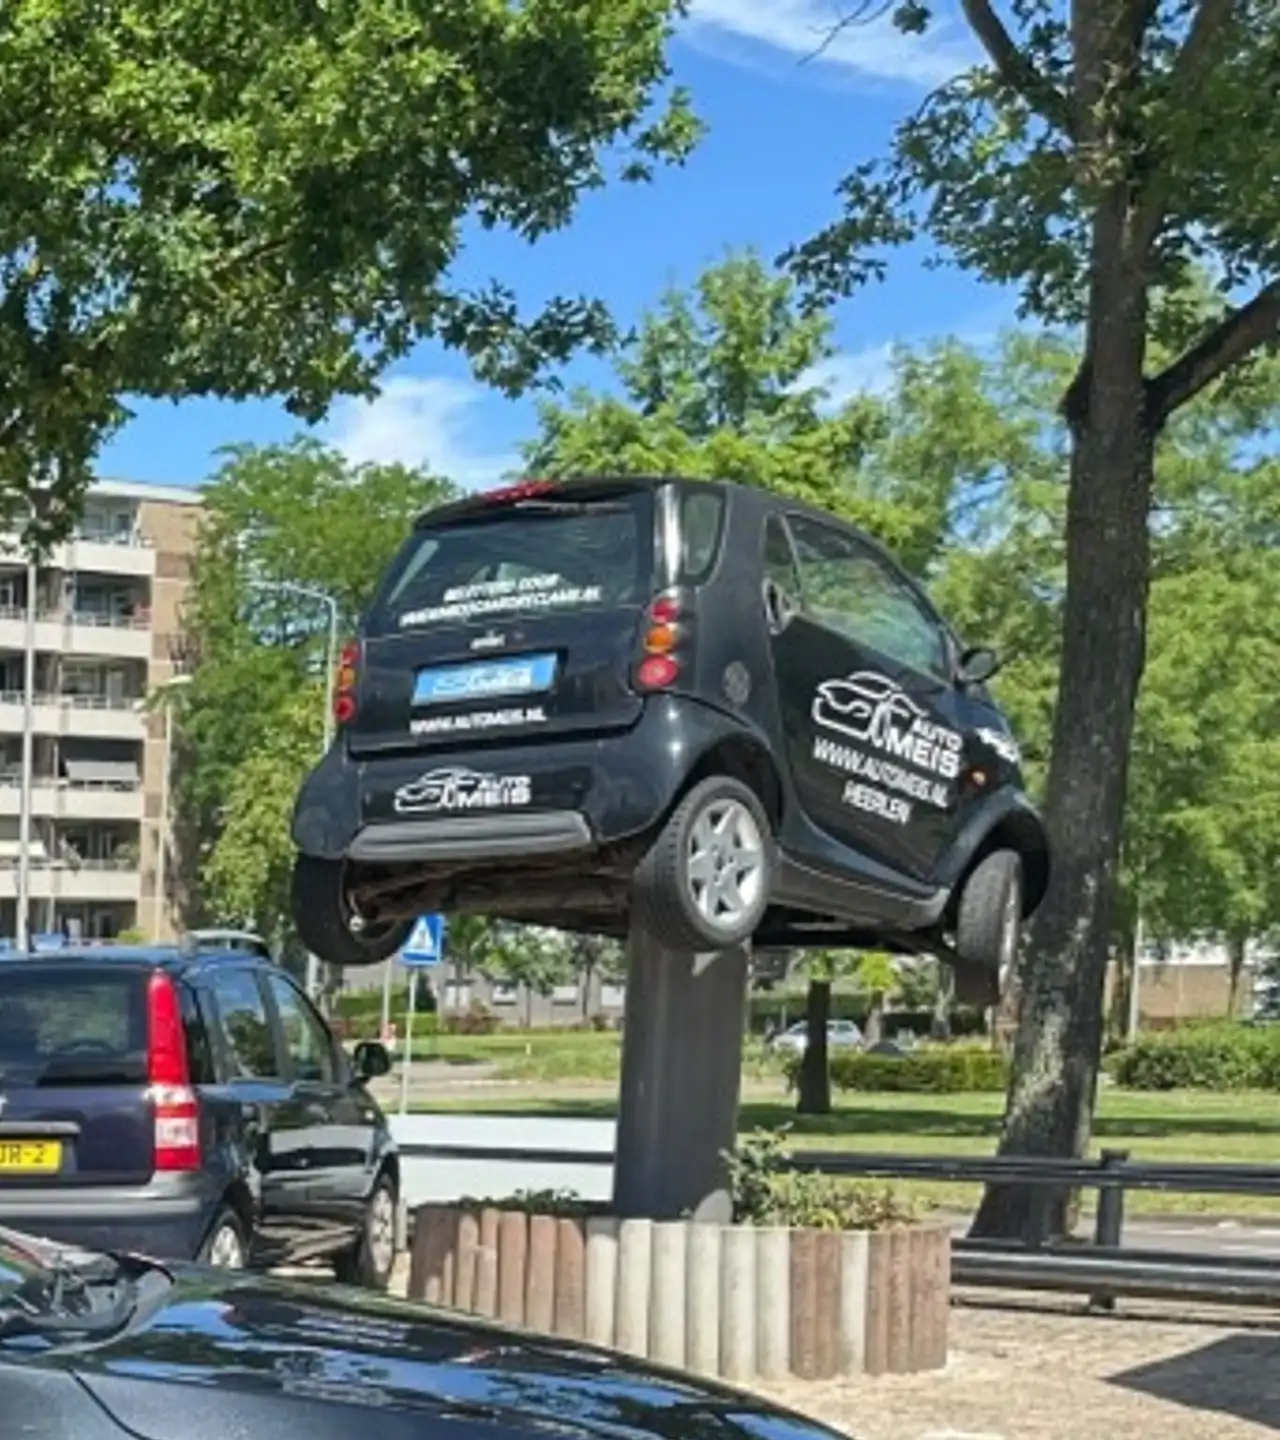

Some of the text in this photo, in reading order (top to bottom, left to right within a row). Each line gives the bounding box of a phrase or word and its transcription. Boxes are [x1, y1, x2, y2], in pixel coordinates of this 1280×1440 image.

[886, 727, 962, 779] MEIS
[911, 717, 963, 751] AUTO
[812, 736, 950, 808] WWW.AUTOMEIS.NL
[457, 787, 532, 808] MEIS
